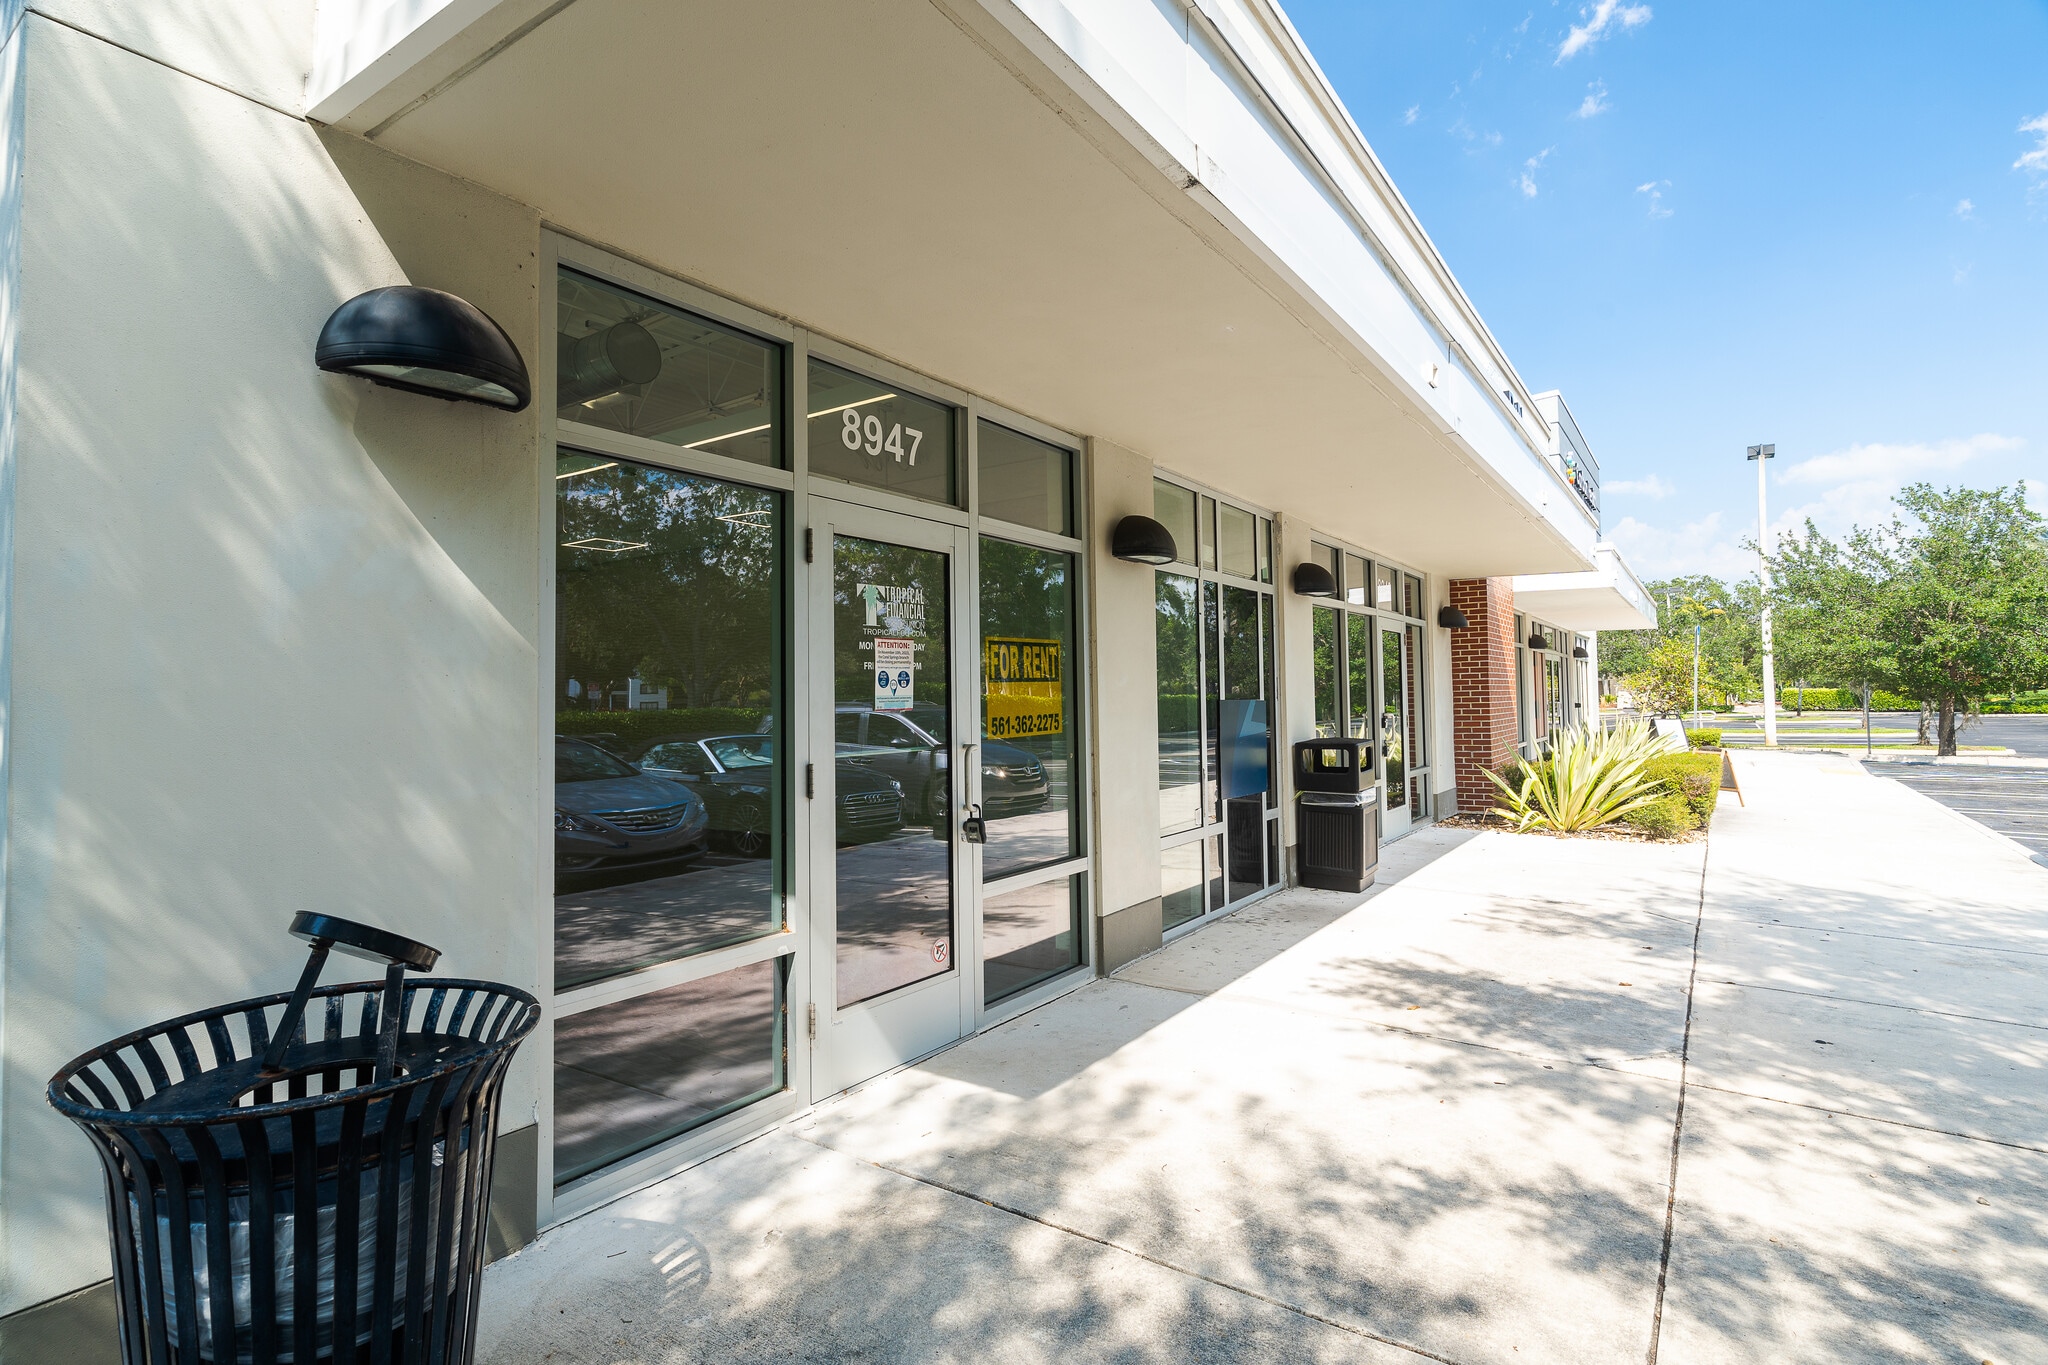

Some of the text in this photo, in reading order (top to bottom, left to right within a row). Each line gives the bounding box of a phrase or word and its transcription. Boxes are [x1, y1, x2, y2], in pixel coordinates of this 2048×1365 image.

[841, 408, 923, 466] 8947
[886, 586, 924, 604] TROPICAL
[886, 602, 926, 619] FINANCIAL
[877, 641, 910, 649] ATTENTION:
[991, 645, 1058, 679] FOR RENT
[991, 713, 1060, 736] 561-362-2275
